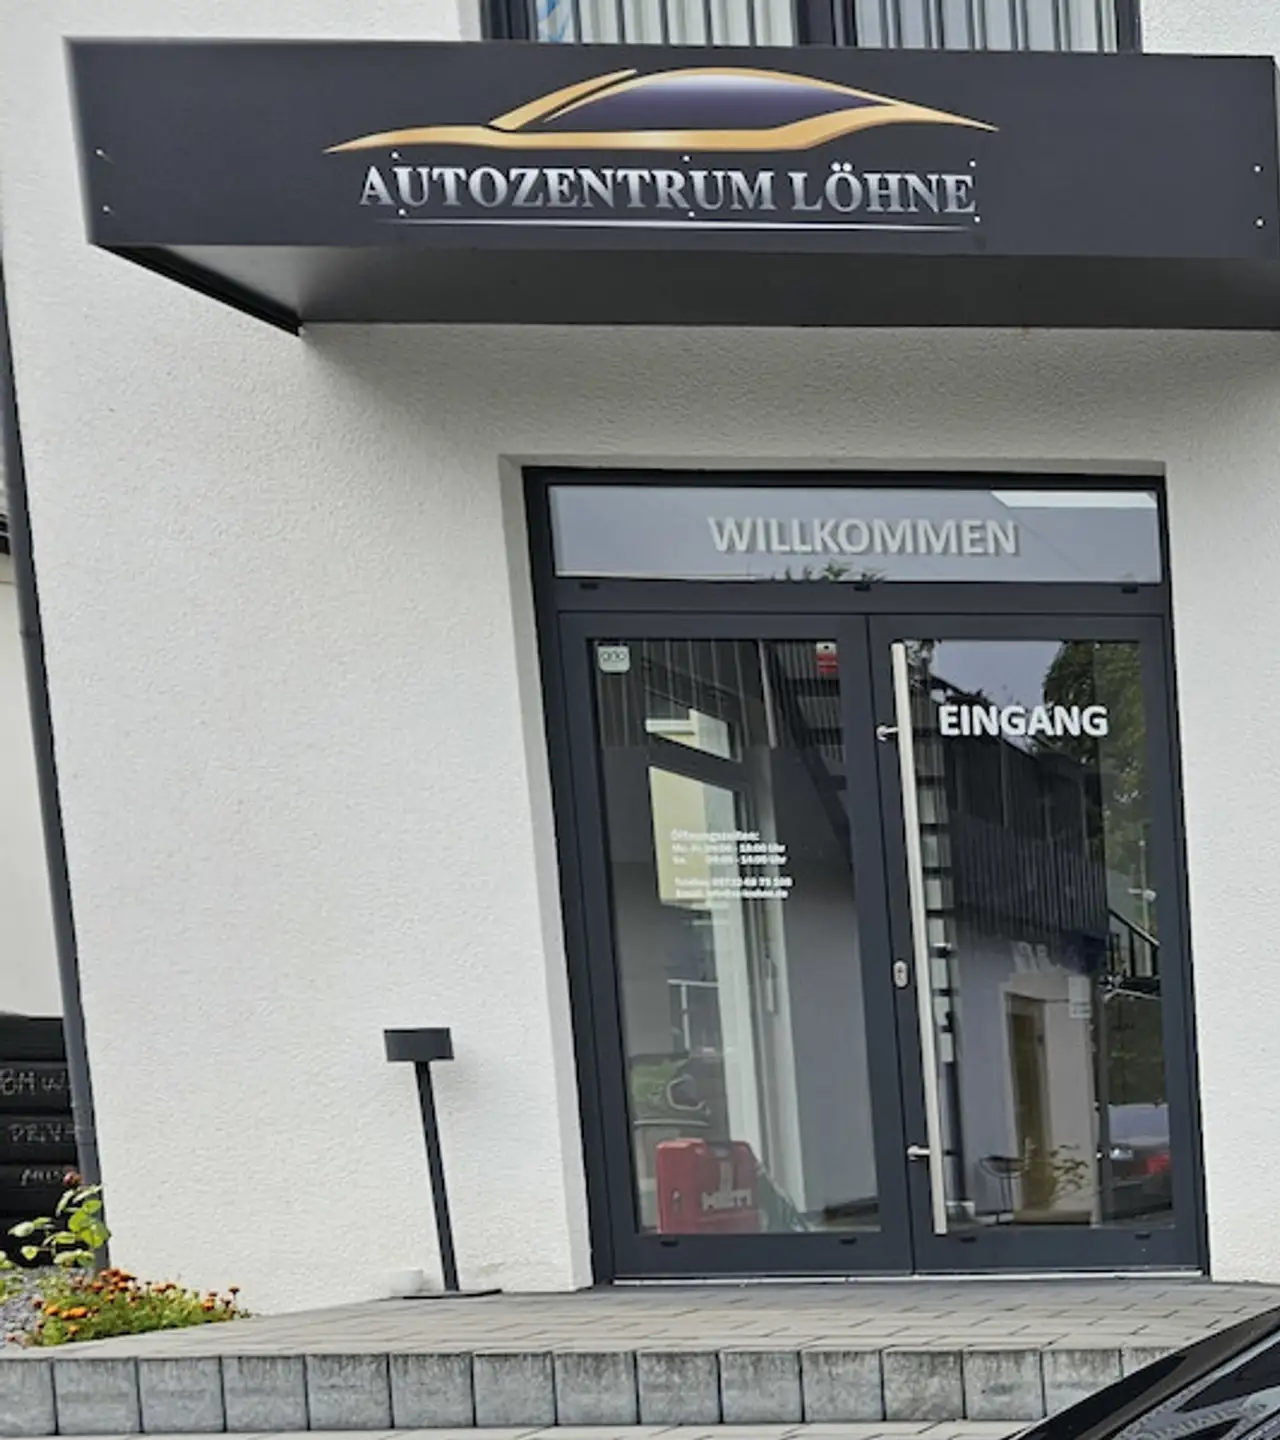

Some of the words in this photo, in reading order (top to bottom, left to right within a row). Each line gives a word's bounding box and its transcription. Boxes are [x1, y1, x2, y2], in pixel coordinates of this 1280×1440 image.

[359, 165, 776, 211] AUTOZENTRUM
[789, 162, 977, 213] LÖHNE
[706, 515, 1018, 555] WILLKOMMEN
[938, 704, 1109, 737] EINGANG
